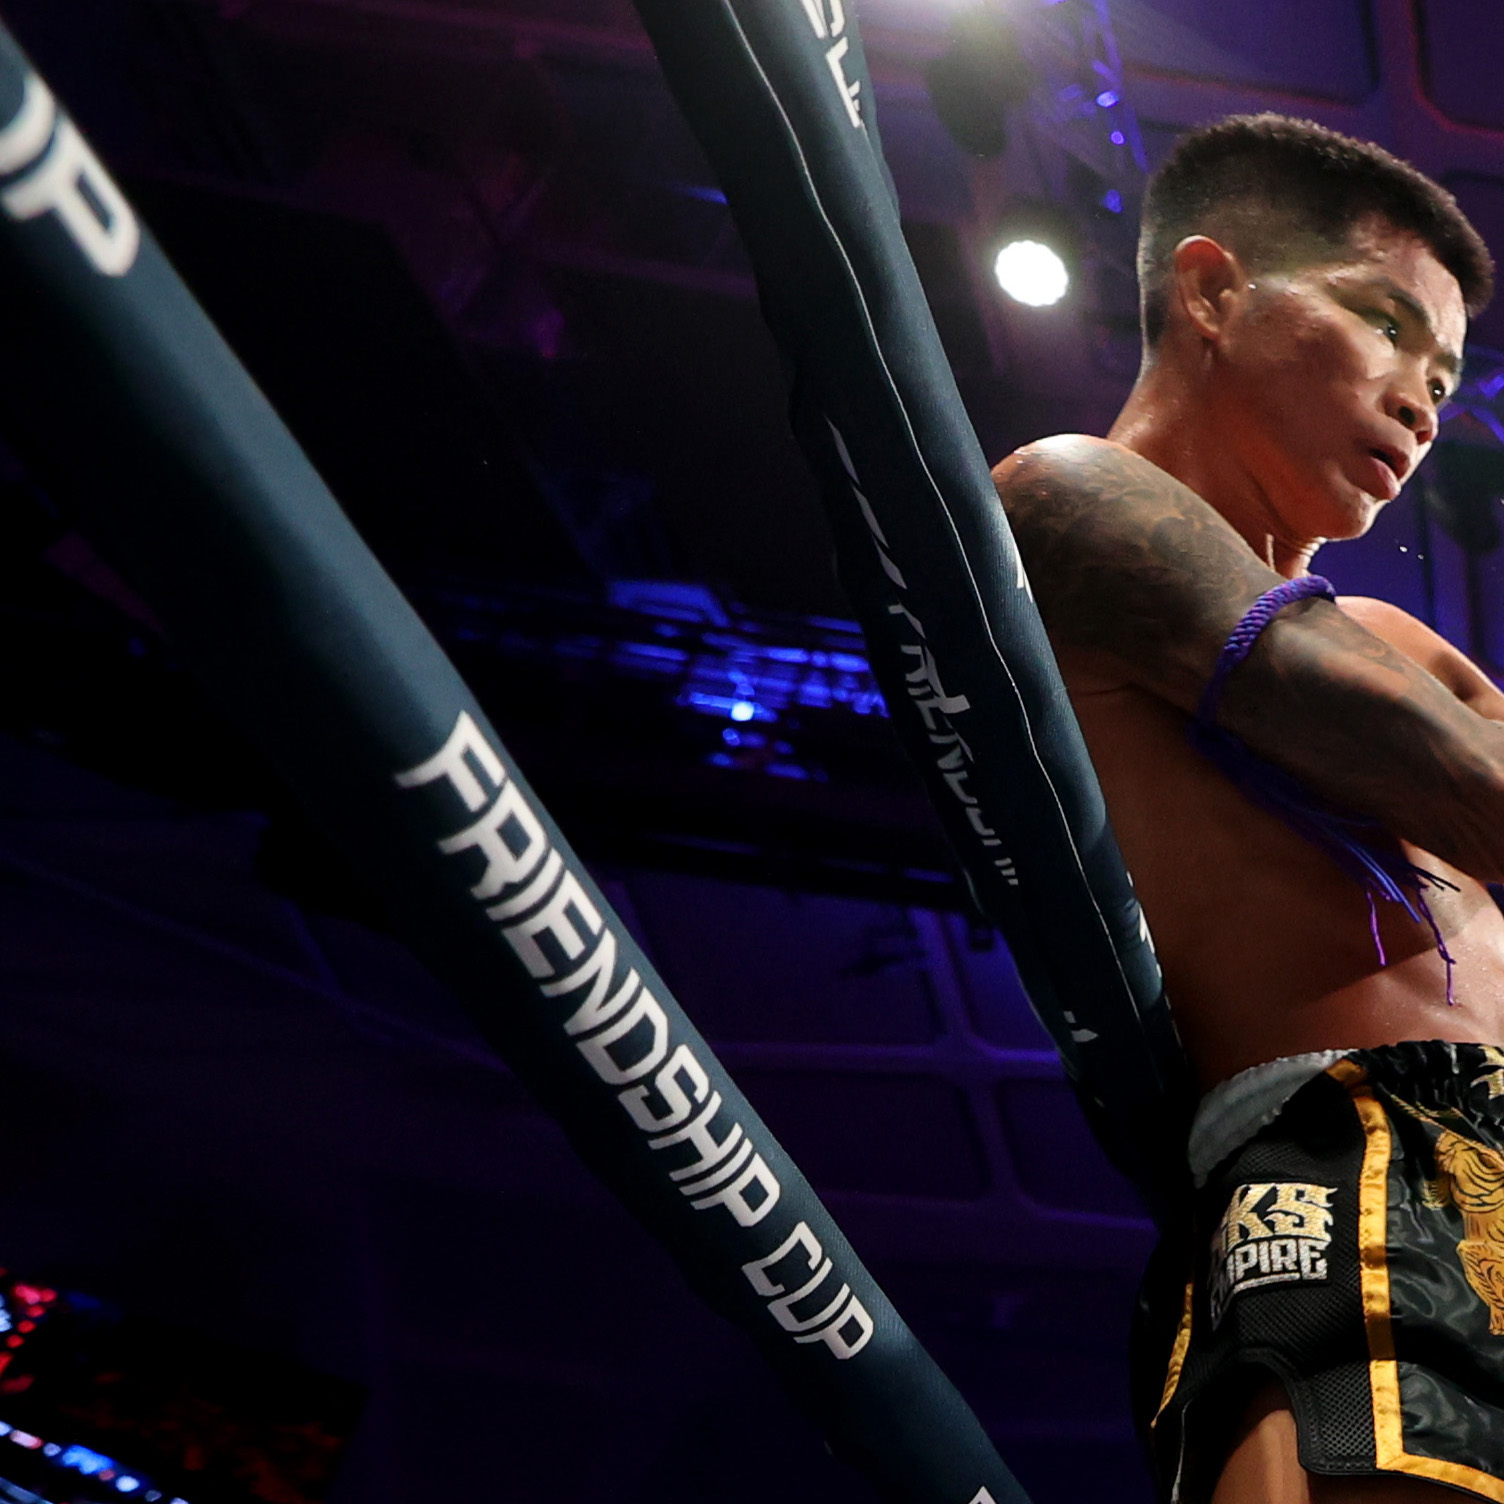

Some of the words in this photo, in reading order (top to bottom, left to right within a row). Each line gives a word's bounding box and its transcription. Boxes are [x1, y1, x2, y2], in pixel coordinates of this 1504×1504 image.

[396, 708, 781, 1228] FRIENDSHIP
[741, 1221, 875, 1361] CUP
[1226, 1238, 1328, 1283] PIRE
